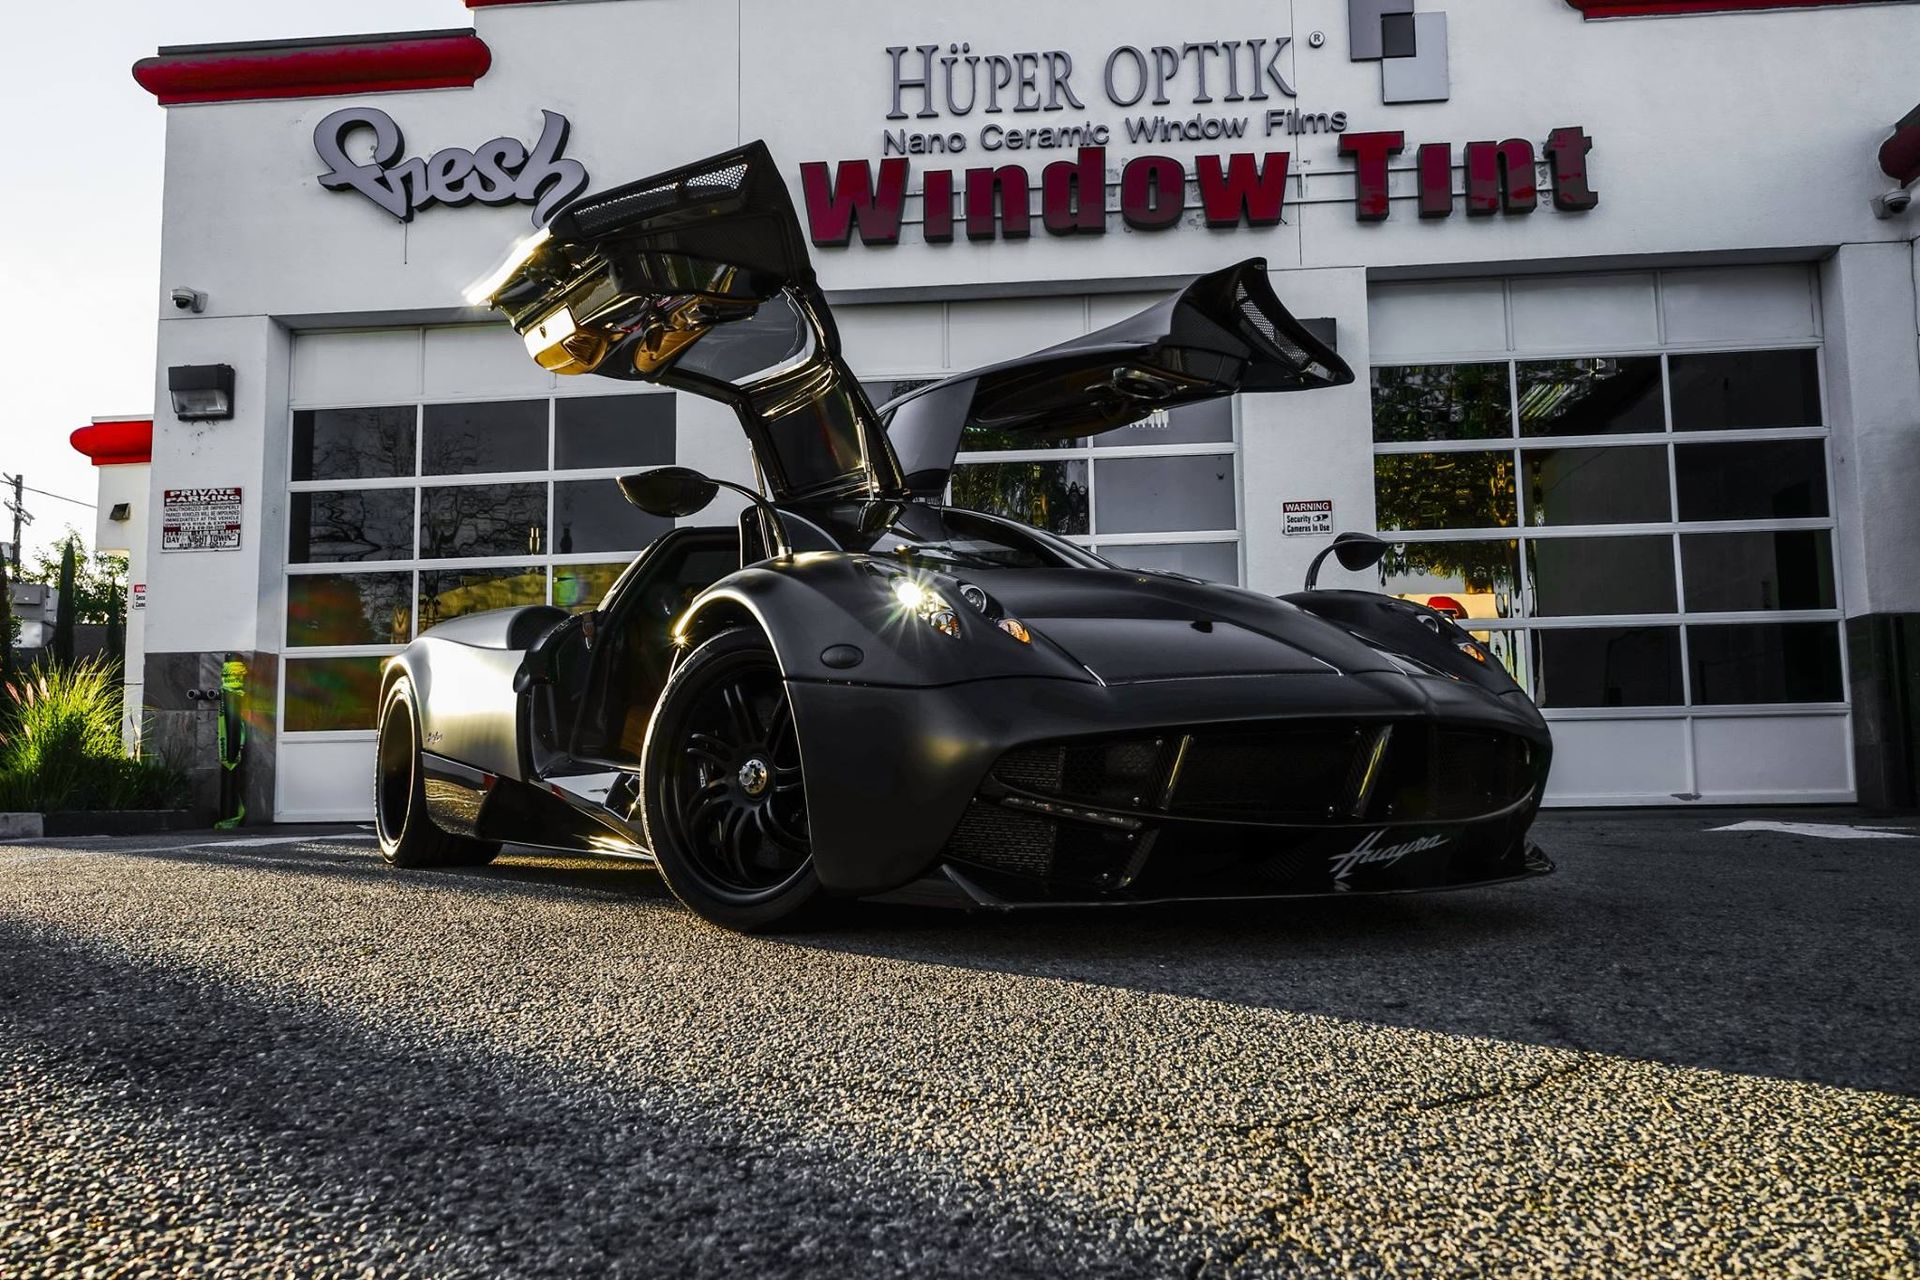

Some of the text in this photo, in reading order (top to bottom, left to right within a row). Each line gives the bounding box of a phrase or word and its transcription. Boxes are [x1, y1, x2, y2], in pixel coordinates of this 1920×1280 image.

[886, 42, 1085, 119] HÜPER
[1104, 36, 1297, 107] OPTIK
[883, 108, 1348, 156] Nano Ceramic Window Films
[1285, 502, 1329, 511] WARNING
[1287, 515, 1311, 524] Security
[1319, 523, 1329, 531] Use
[1328, 827, 1450, 880] Huayra
